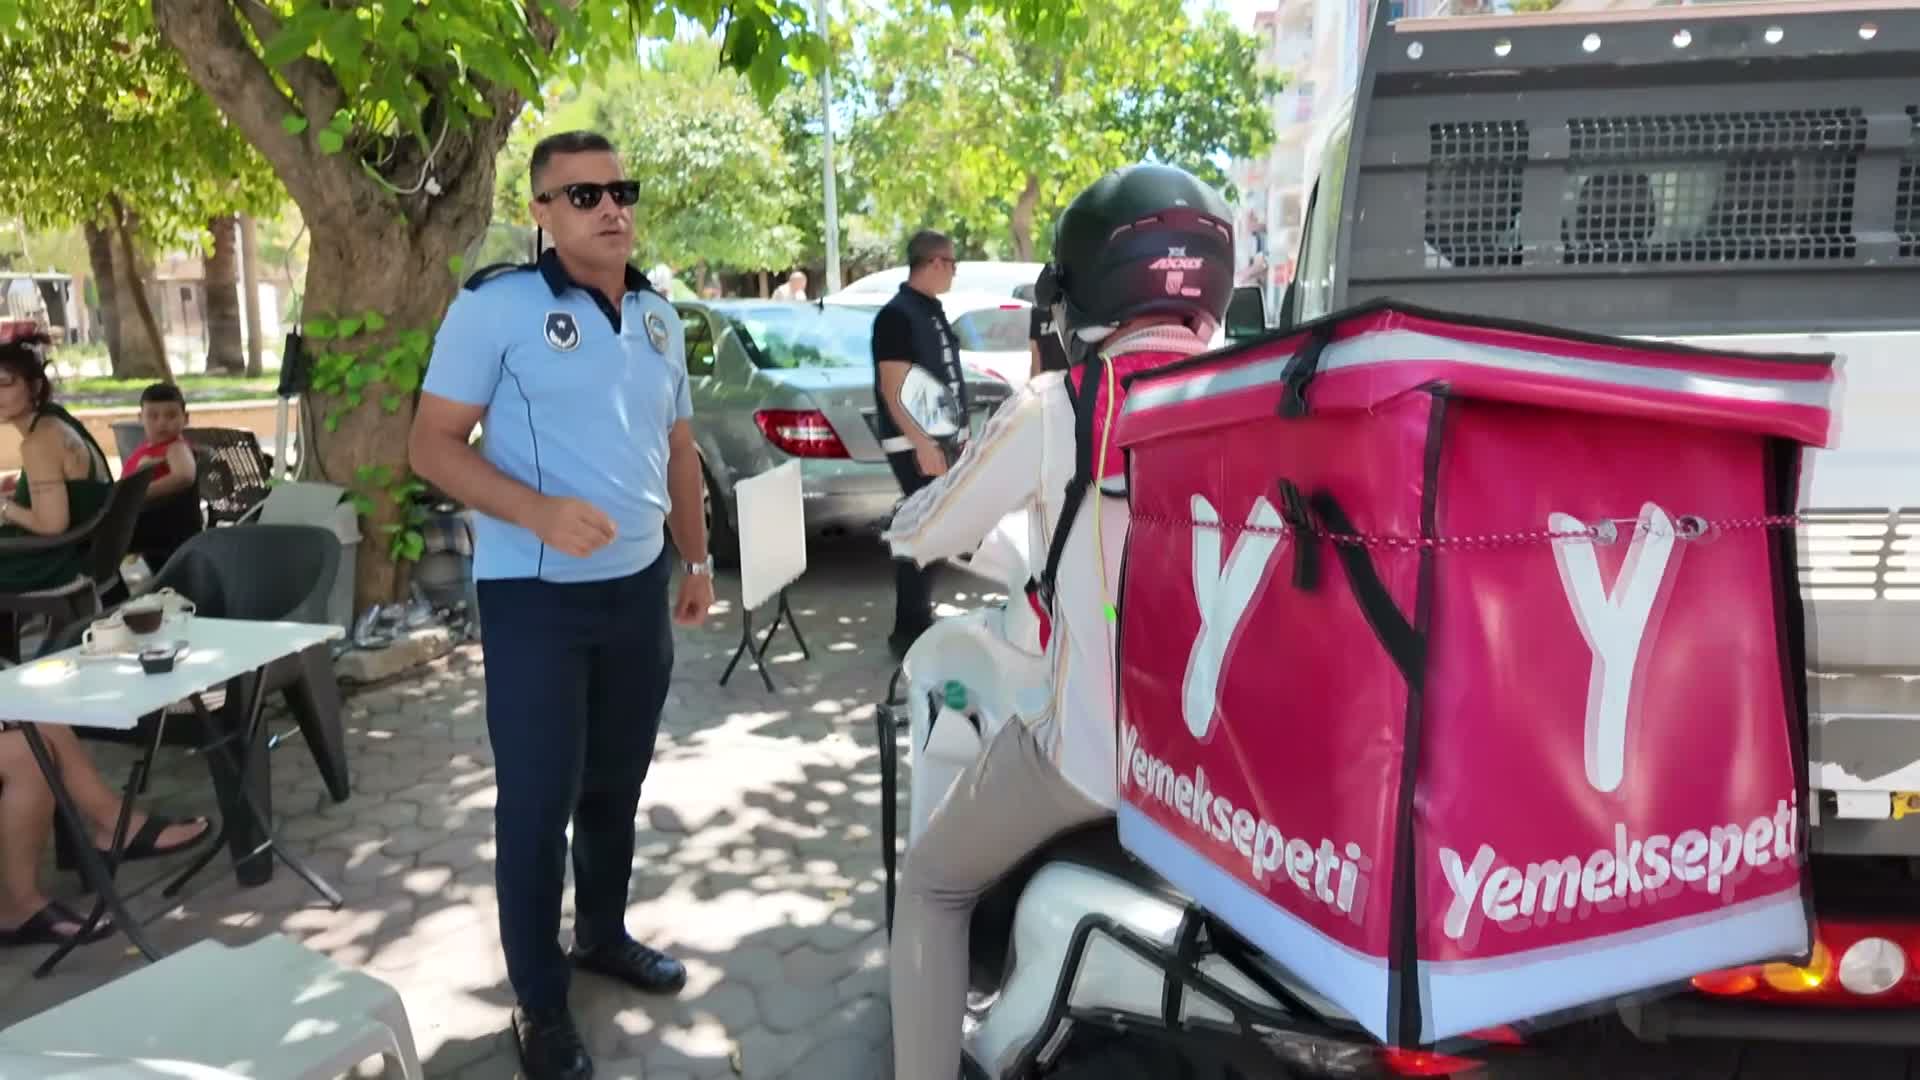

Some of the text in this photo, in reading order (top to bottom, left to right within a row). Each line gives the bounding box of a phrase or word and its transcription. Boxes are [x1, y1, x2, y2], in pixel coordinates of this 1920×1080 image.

[1182, 493, 1285, 738] Y
[1548, 501, 1675, 792] Y
[1121, 718, 1363, 913] Yemeksepeti
[1439, 787, 1797, 939] Yemeksepeti
